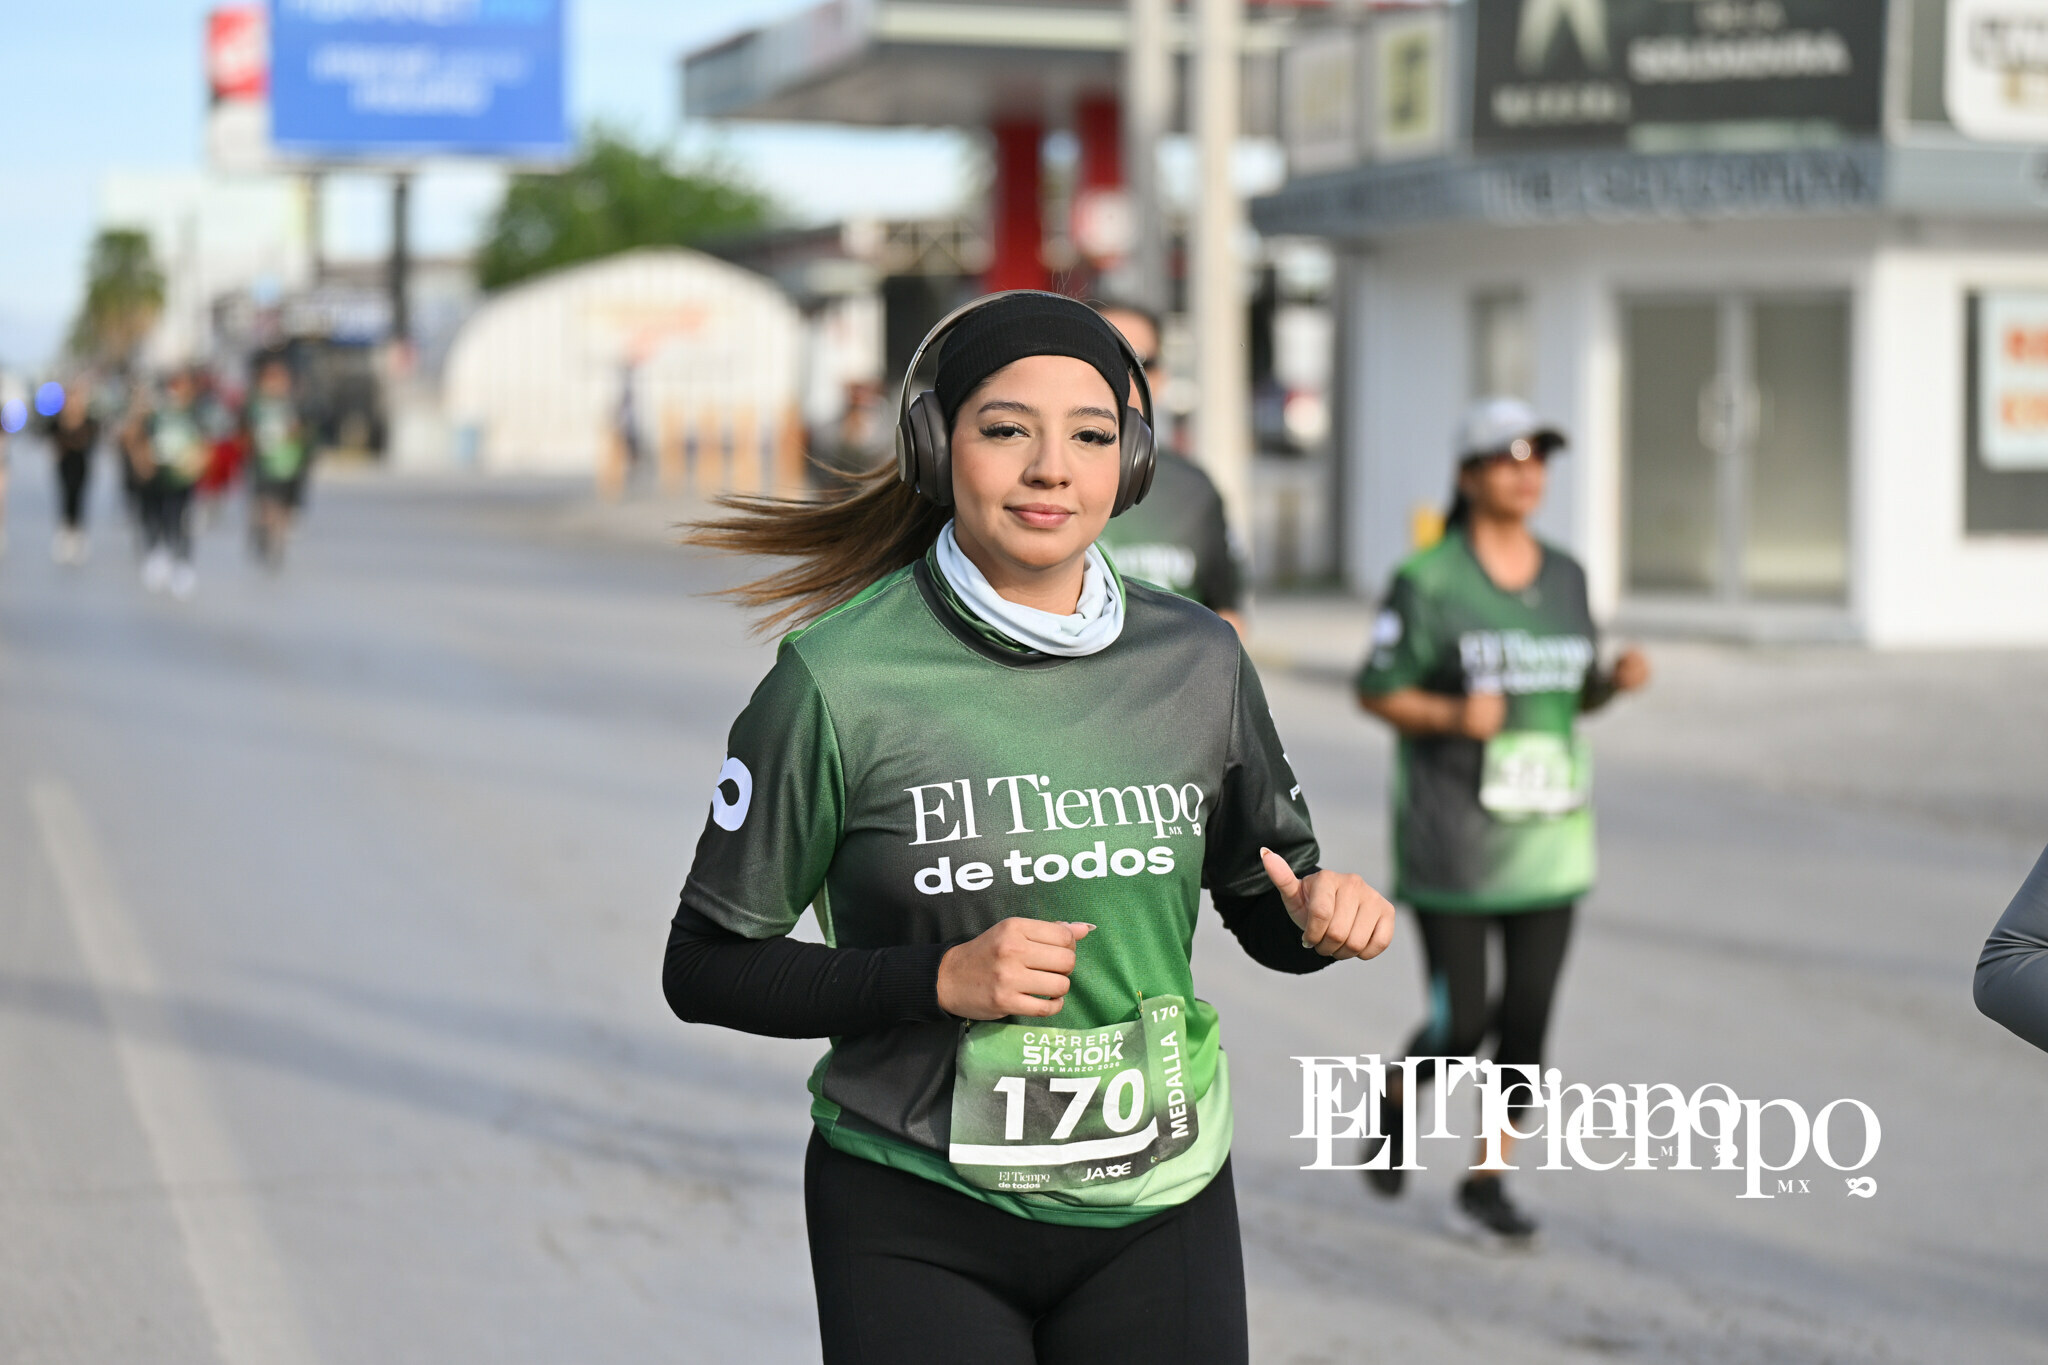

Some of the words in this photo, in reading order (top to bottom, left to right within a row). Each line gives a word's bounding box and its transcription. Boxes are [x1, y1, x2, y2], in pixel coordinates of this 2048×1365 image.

[904, 778, 982, 845] El
[987, 774, 1203, 839] Tiempo
[1168, 826, 1182, 835] MX
[914, 857, 993, 895] de
[1004, 841, 1174, 885] todos
[1151, 1005, 1178, 1023] 170
[1023, 1030, 1123, 1047] CARRERA
[1160, 1030, 1189, 1139] MEDALLA
[993, 1069, 1144, 1140] 170
[999, 1172, 1010, 1181] El
[1011, 1171, 1050, 1183] Tiempo
